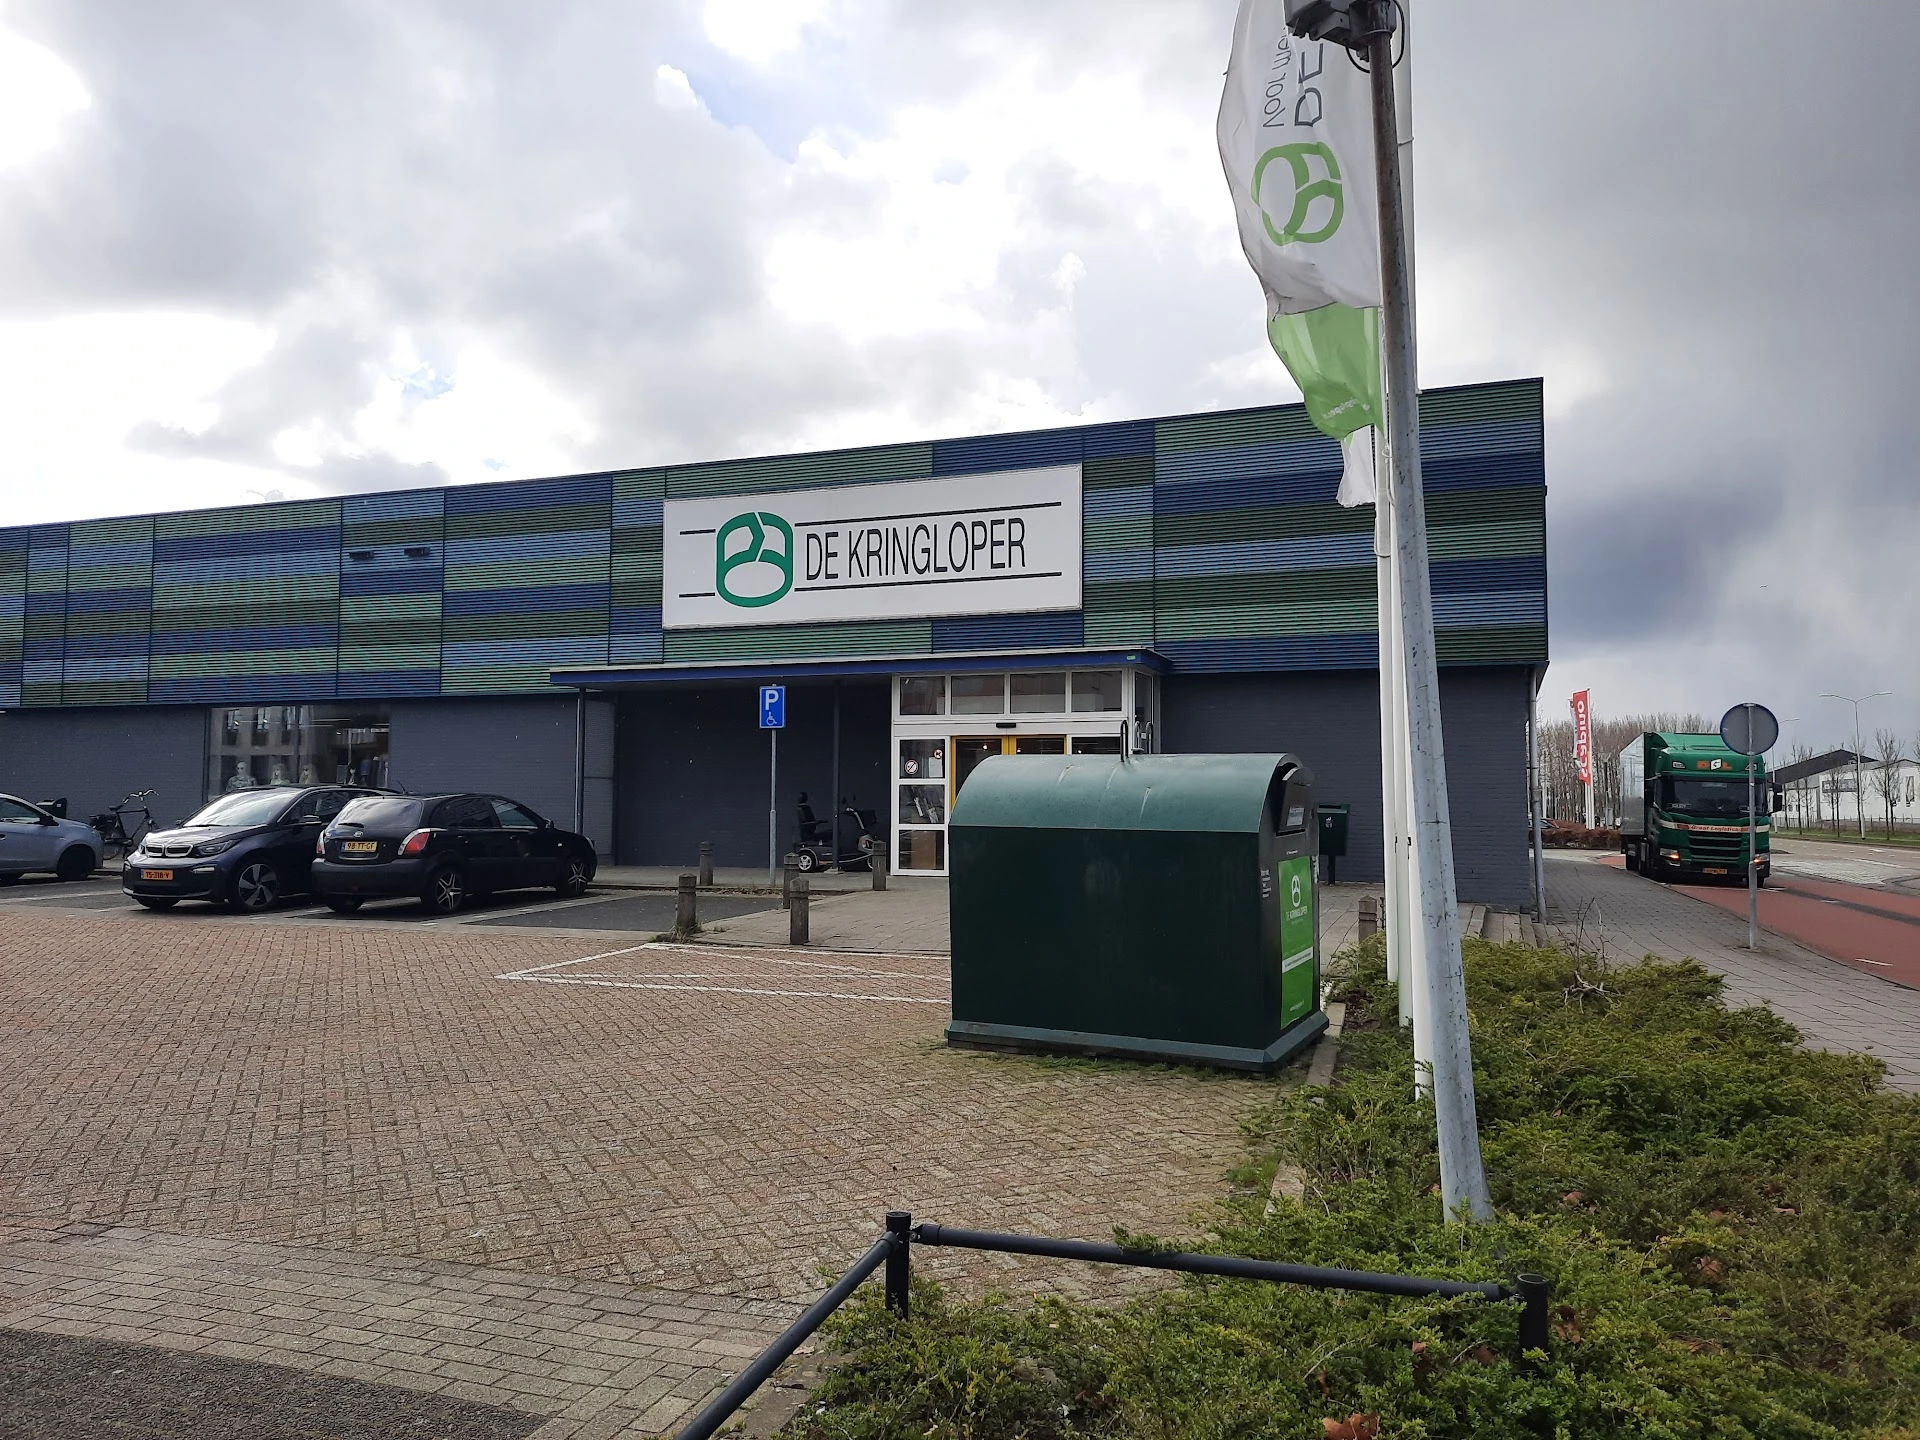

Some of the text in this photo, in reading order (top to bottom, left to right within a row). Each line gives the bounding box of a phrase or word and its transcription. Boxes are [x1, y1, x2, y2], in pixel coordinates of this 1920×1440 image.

[806, 517, 1026, 581] DE KRINGLOPER
[765, 689, 779, 711] P
